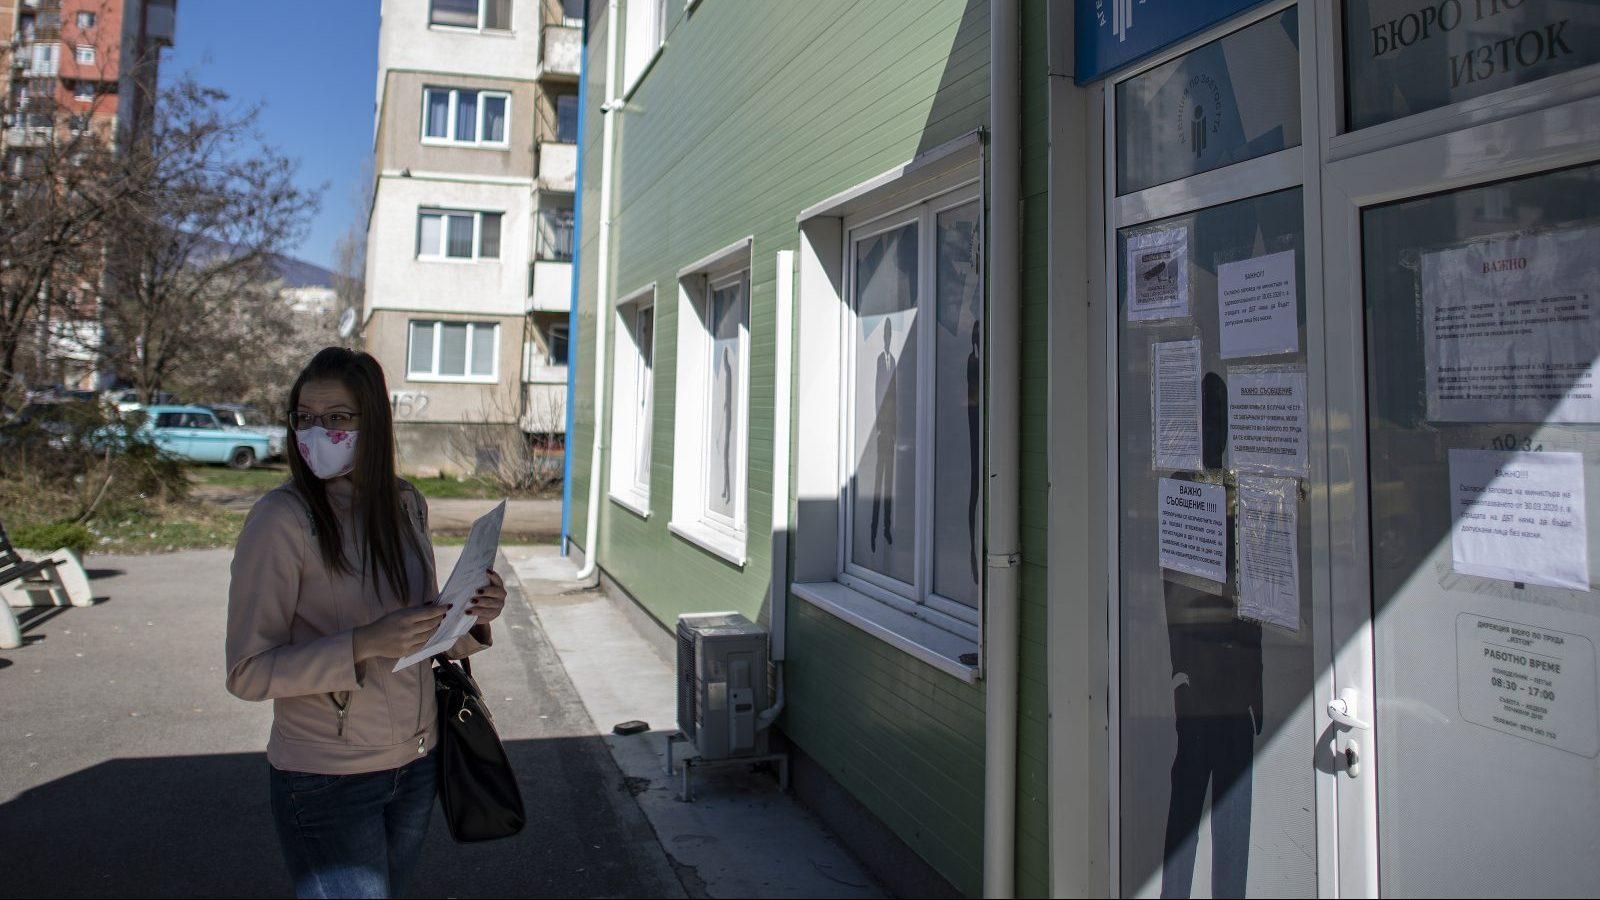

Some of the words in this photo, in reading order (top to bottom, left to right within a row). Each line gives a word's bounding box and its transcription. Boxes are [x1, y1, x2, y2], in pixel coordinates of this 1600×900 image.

[1370, 0, 1462, 57] БЮРО
[1449, 18, 1574, 89] ИЗТОК
[1480, 257, 1527, 273] ВАЖНО
[1166, 496, 1206, 511] СЪОБЩЕНИЕ
[1180, 486, 1202, 497] ВАЖНО
[1484, 648, 1527, 666] РАБОТНО
[1529, 658, 1561, 674] ВРЕМЕ
[1491, 676, 1517, 692] 08:30
[1528, 686, 1556, 702] 17:00
